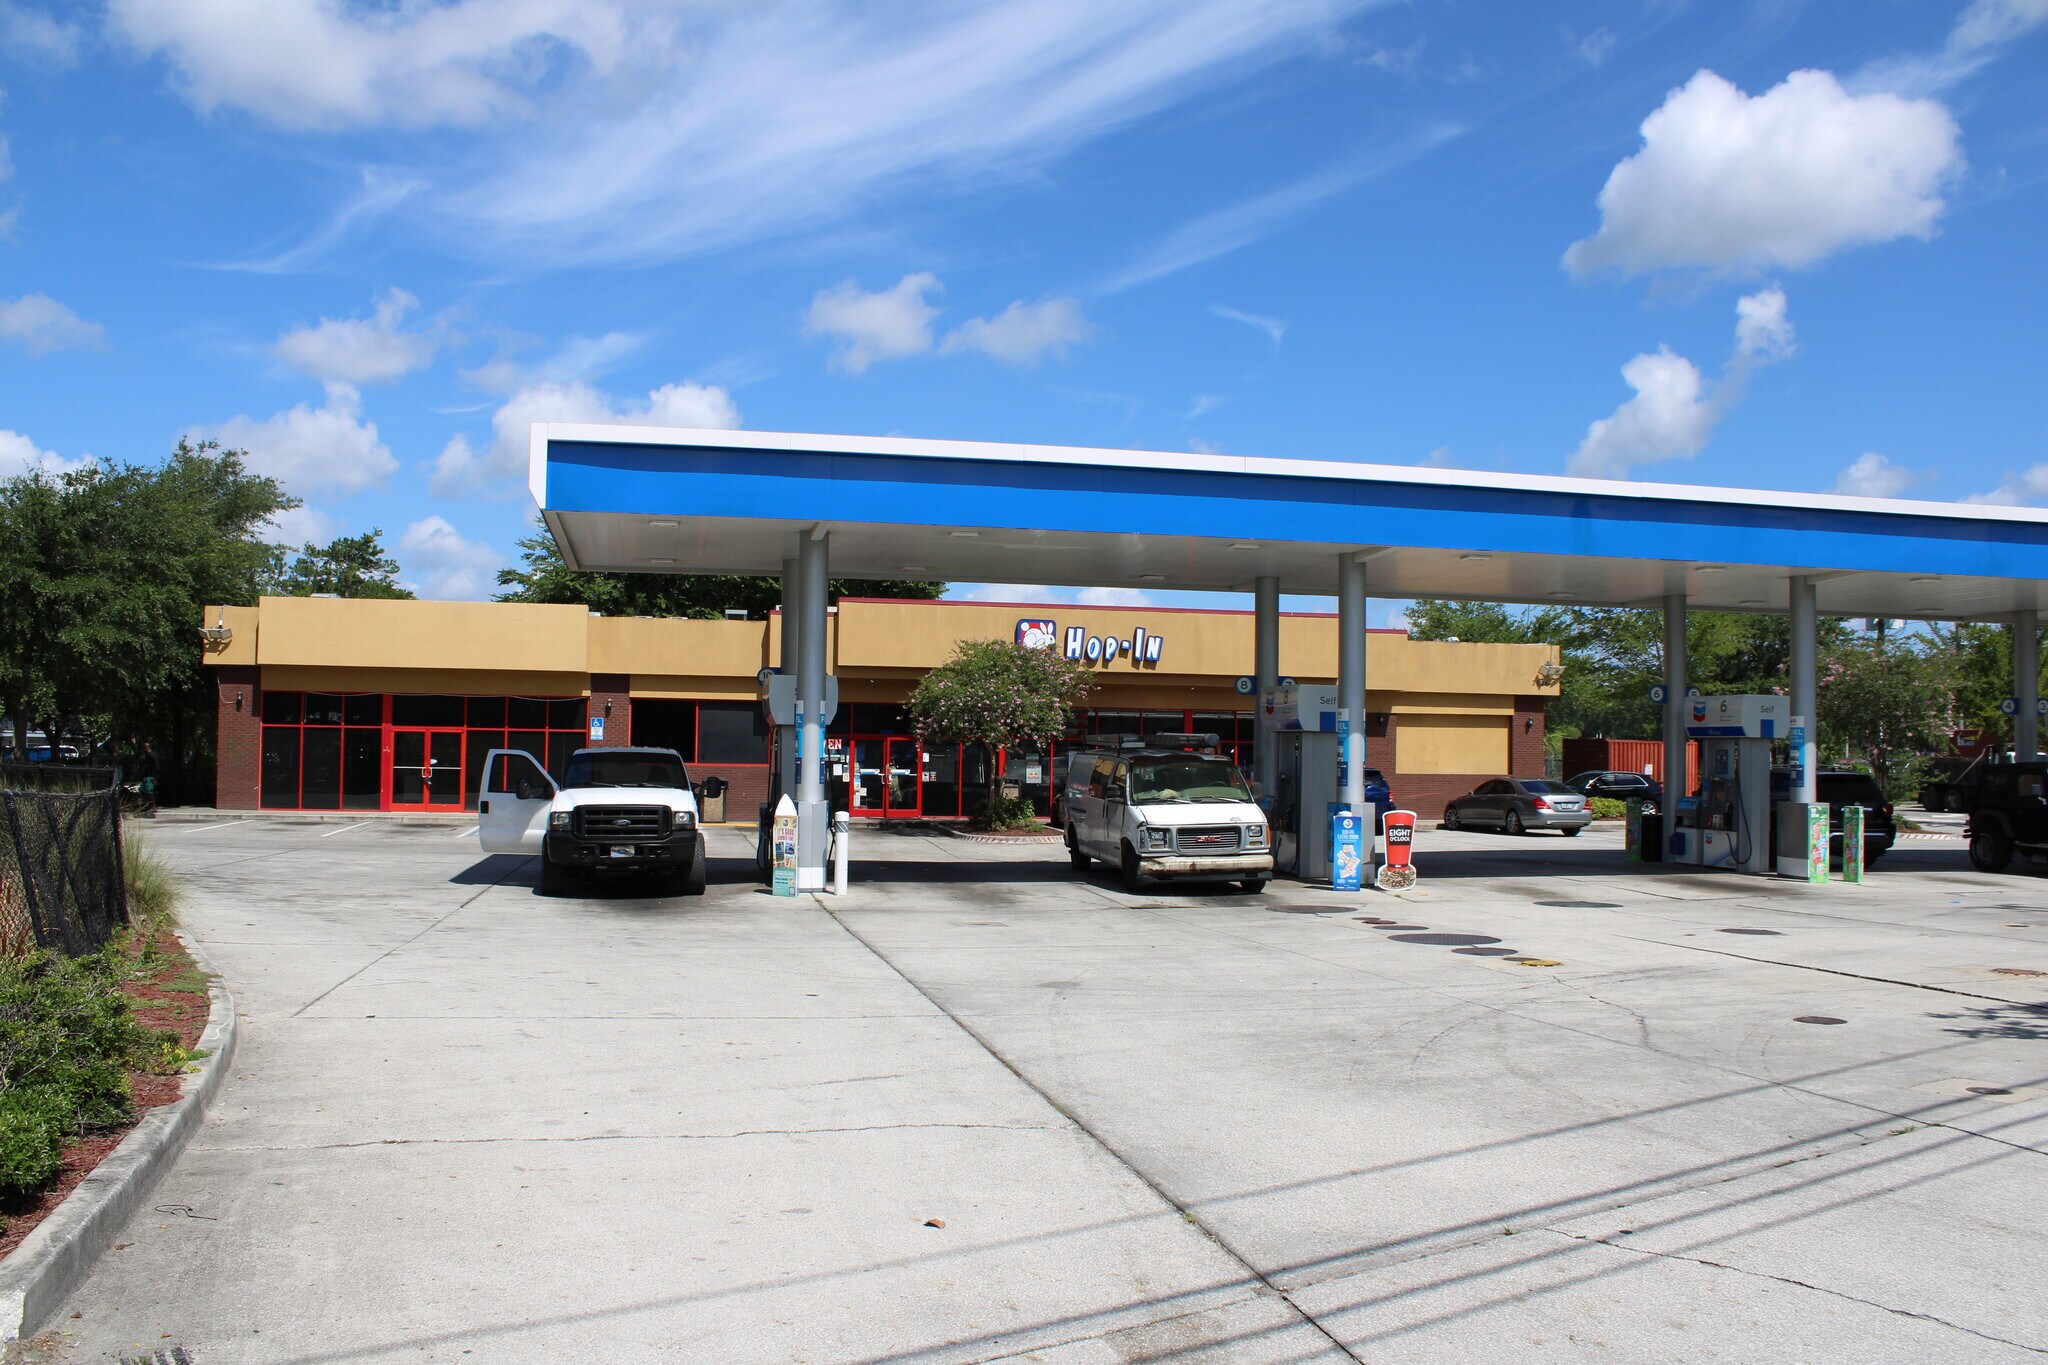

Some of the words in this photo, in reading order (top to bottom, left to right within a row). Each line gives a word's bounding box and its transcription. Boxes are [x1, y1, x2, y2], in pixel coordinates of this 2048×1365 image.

[1065, 626, 1163, 662] Hop-In
[1240, 680, 1248, 690] 8
[1283, 690, 1289, 704] 8
[1653, 688, 1661, 698] 6
[1319, 696, 1337, 705] Self
[1720, 700, 1727, 713] 6
[1760, 705, 1775, 714] Self
[2004, 701, 2012, 710] 4
[2040, 702, 2047, 711] 3
[1389, 829, 1411, 837] EIGHT
